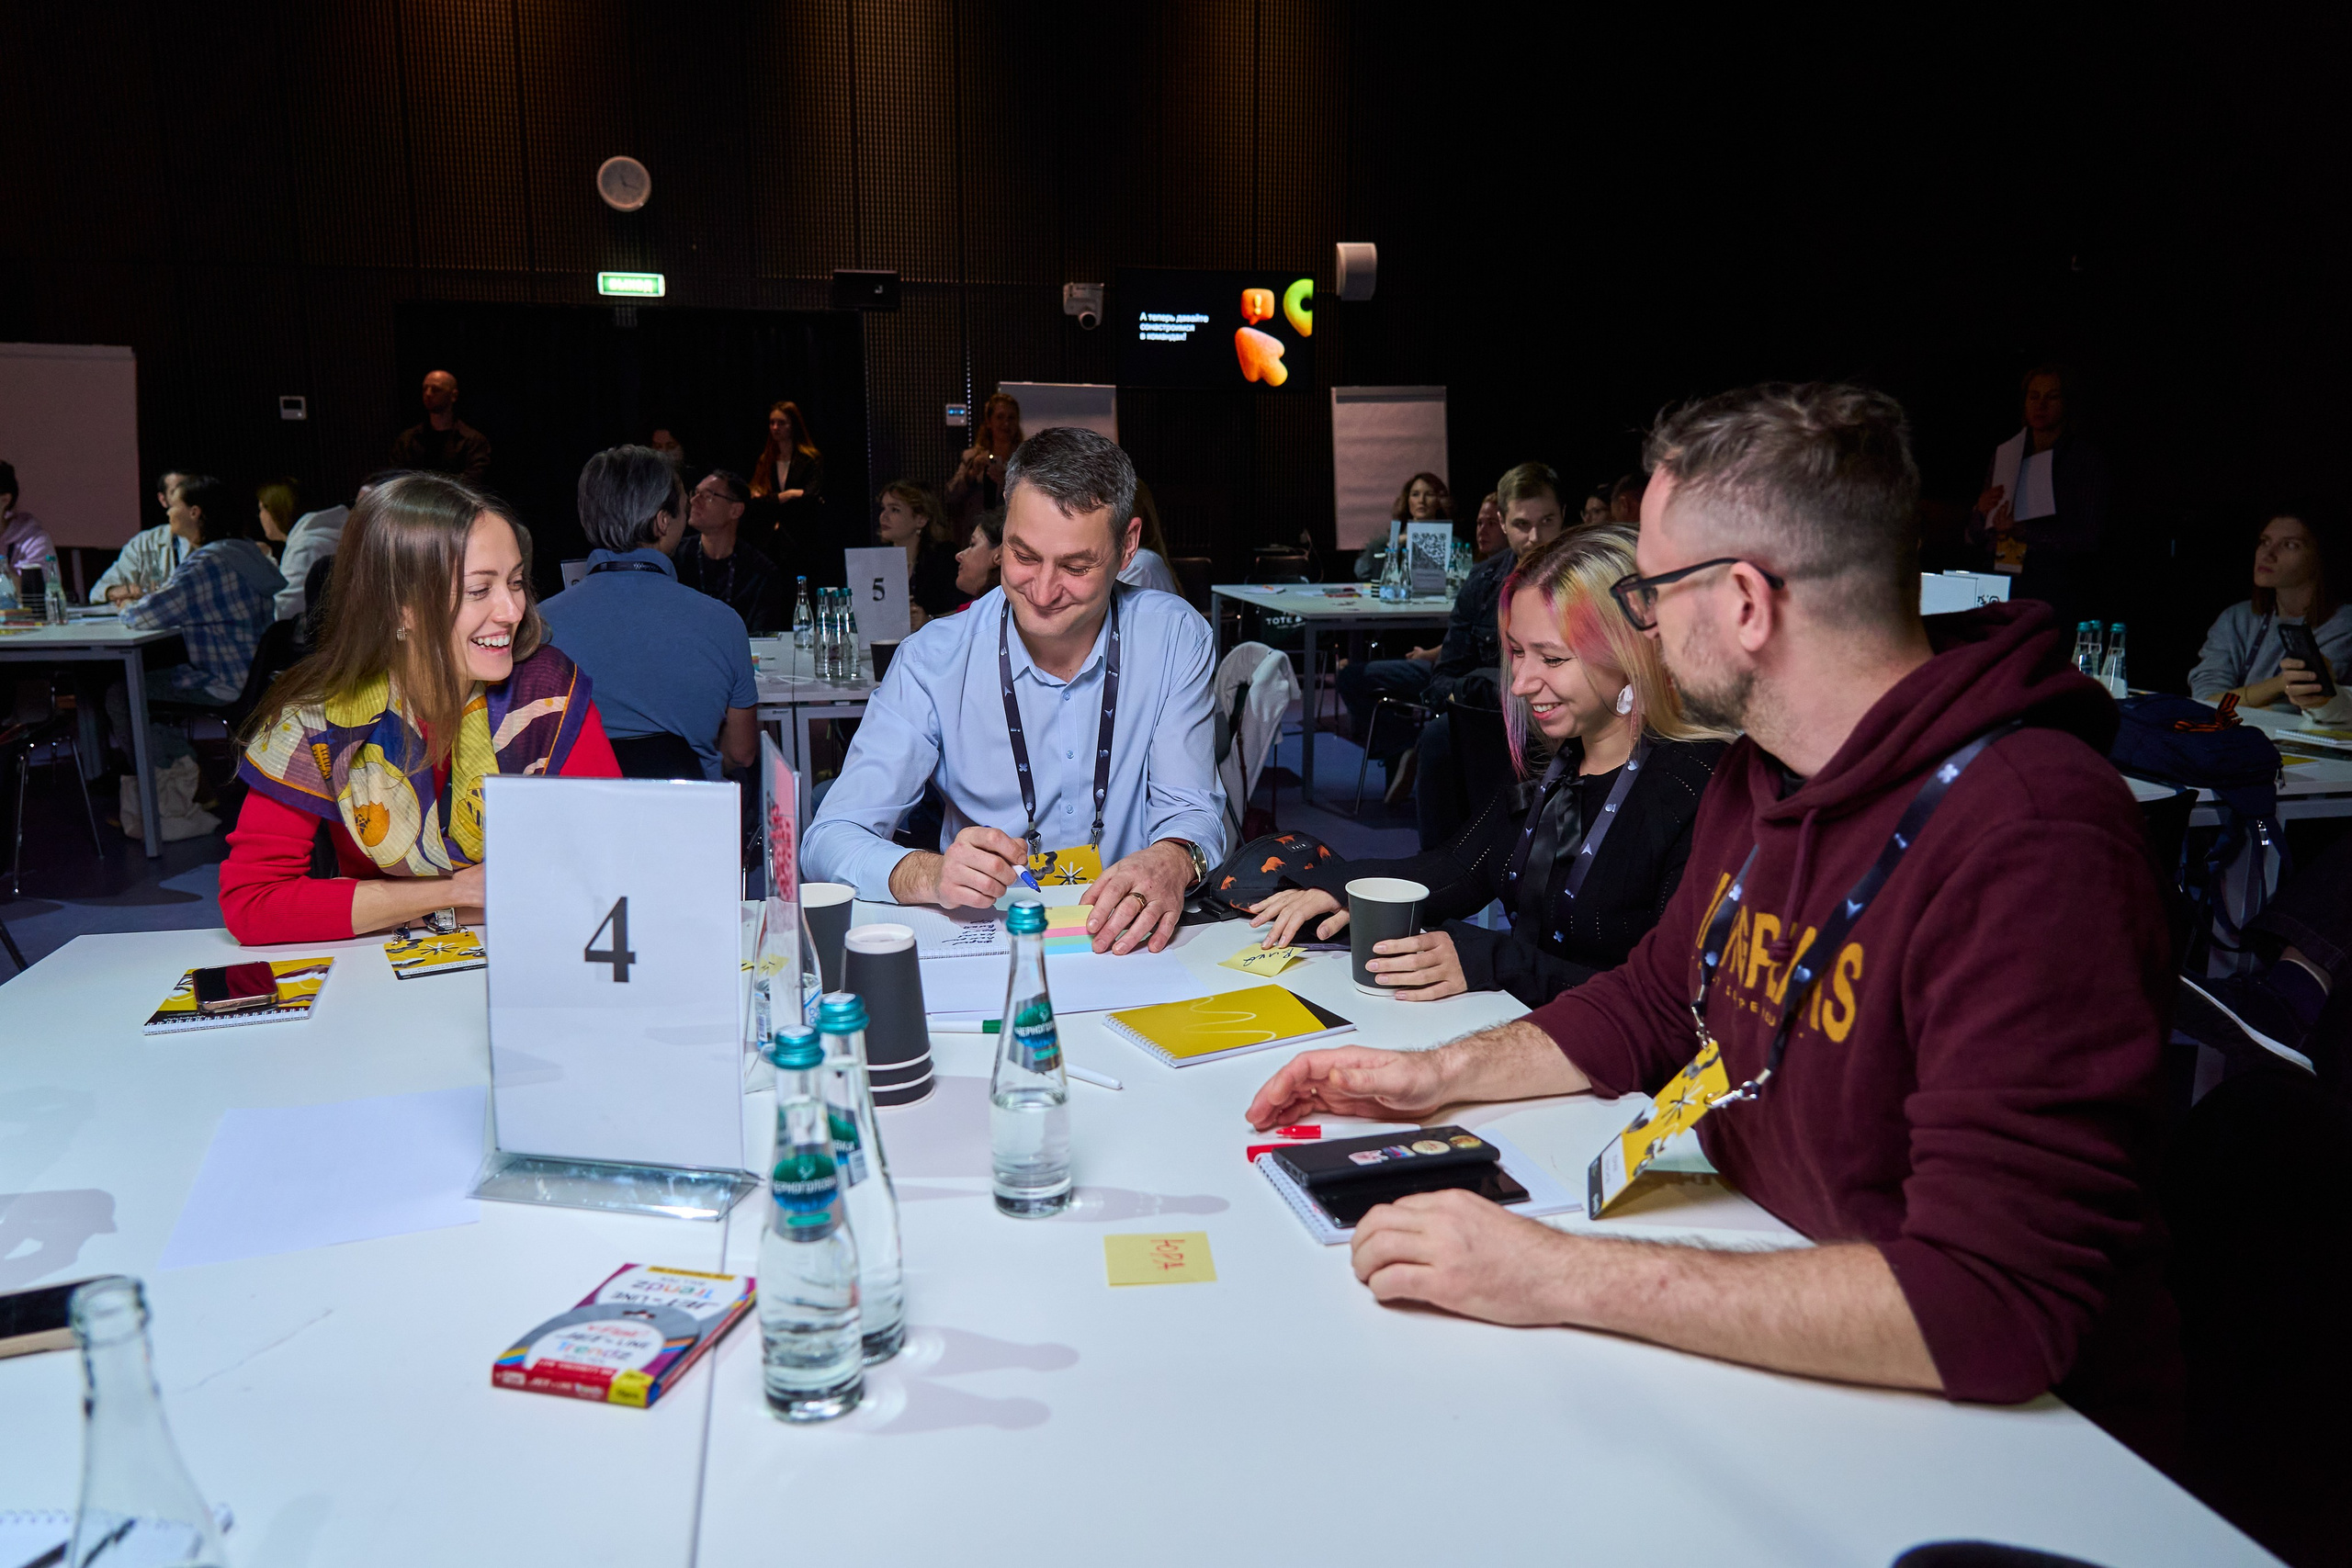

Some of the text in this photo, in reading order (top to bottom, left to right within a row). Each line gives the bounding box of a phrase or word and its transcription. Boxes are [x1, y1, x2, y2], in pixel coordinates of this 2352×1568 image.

[608, 277, 653, 293] ВЫХОД
[1139, 311, 1209, 323] А теперь давайте
[1139, 332, 1147, 341] в
[872, 577, 886, 602] 5
[584, 896, 636, 983] 4
[631, 1280, 715, 1301] Trendz
[558, 1340, 632, 1360] Trendz
